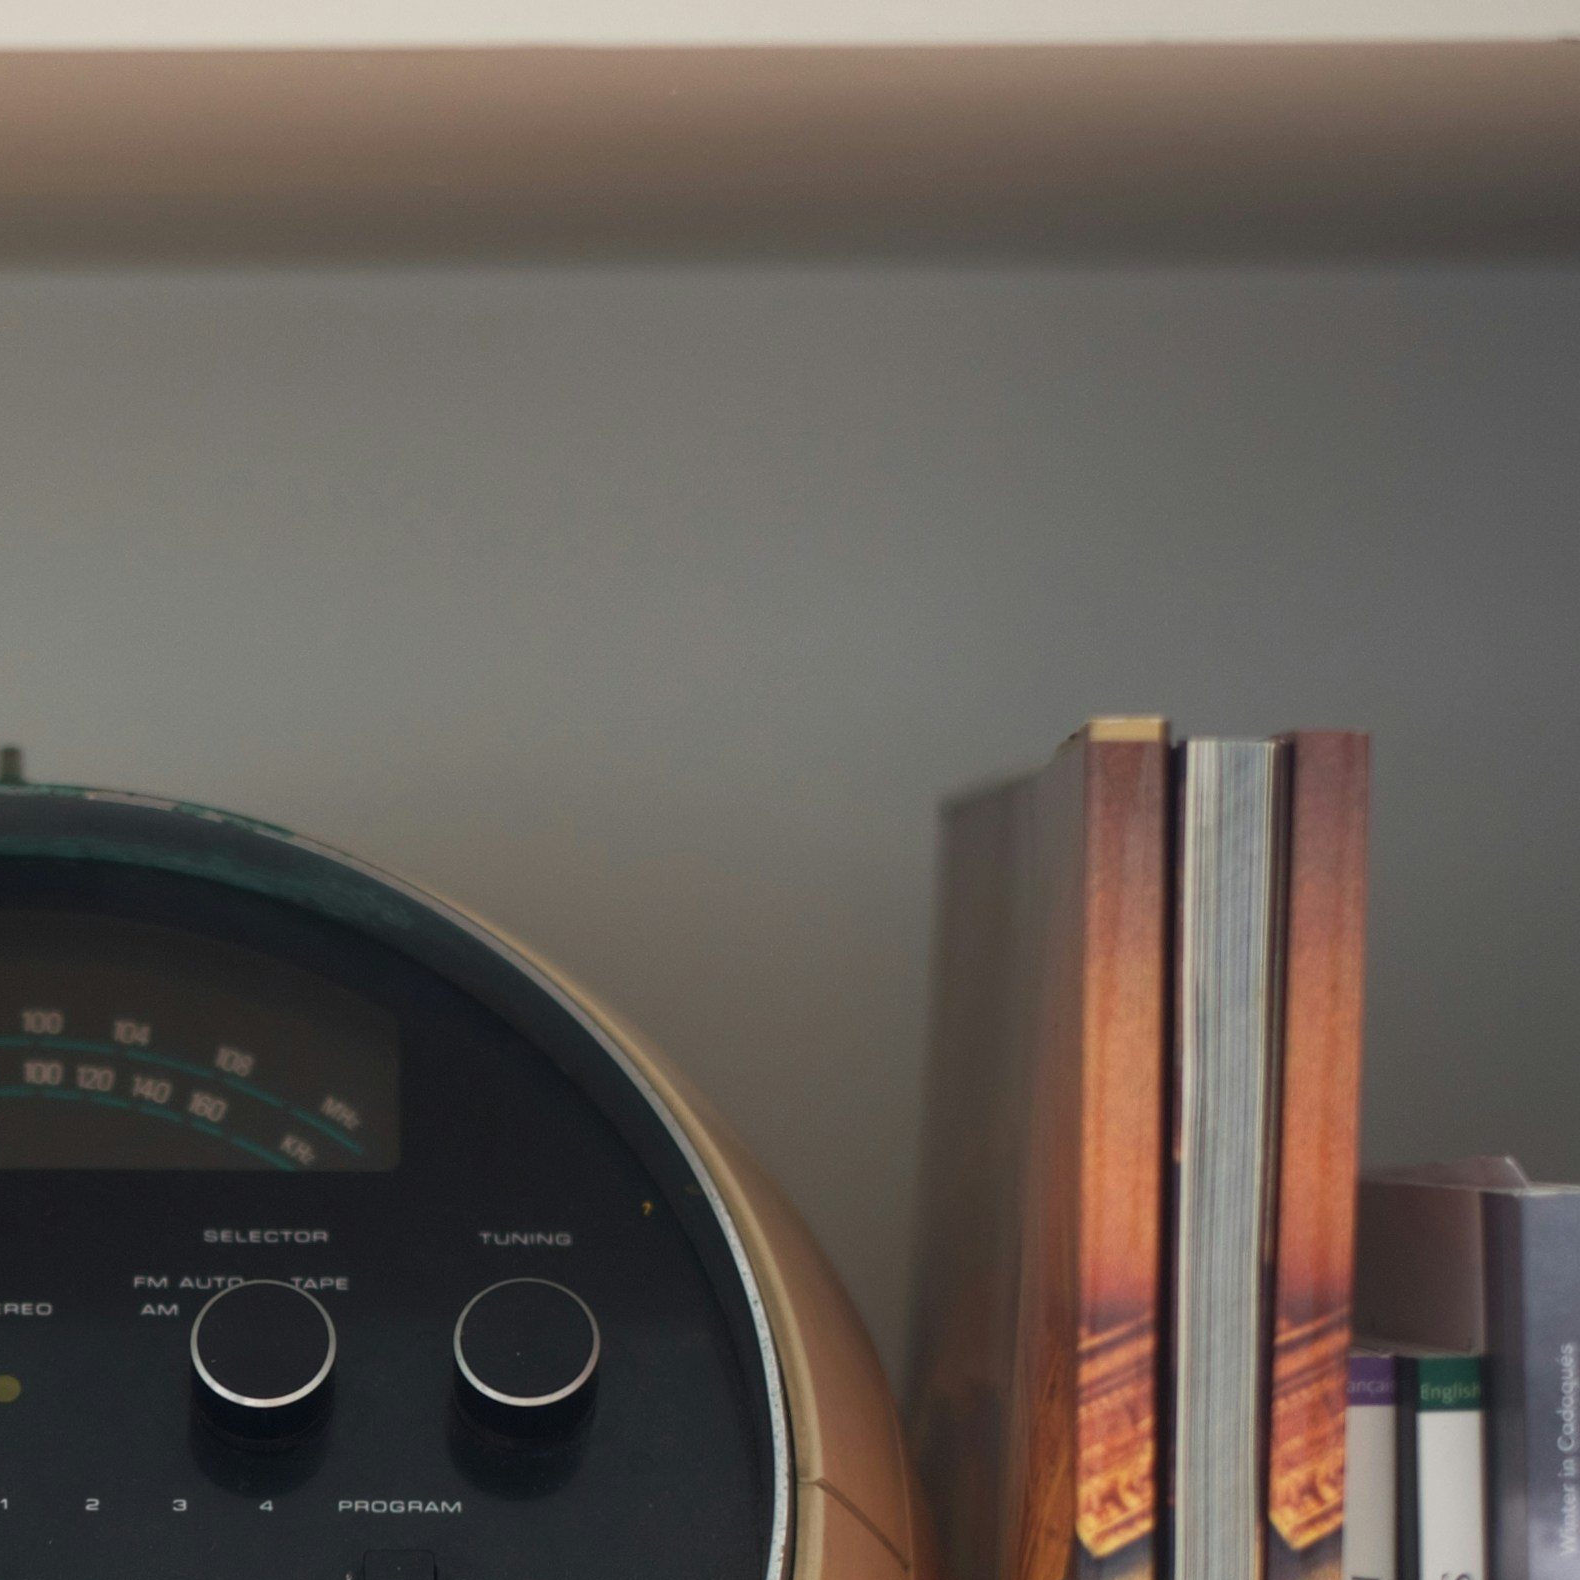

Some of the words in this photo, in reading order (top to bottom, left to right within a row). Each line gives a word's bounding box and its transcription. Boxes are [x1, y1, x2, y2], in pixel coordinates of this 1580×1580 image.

[22, 1009, 64, 1035] 100
[24, 1059, 64, 1086] 100
[77, 1065, 116, 1092] 120
[132, 1074, 172, 1105] 140
[203, 1229, 330, 1243] SELECTOR
[479, 1232, 573, 1246] TUNING
[133, 1275, 169, 1289] FM
[290, 1276, 350, 1291] TAPE
[140, 1303, 179, 1317] AM
[1555, 1344, 1579, 1452] Cadaqués
[1557, 1460, 1576, 1478] in
[0, 1497, 9, 1511] 1
[84, 1498, 101, 1512] 2
[171, 1498, 188, 1512] 3
[258, 1499, 275, 1513] 4
[337, 1500, 463, 1514] PROGRAM
[1559, 1483, 1576, 1556] Winter
